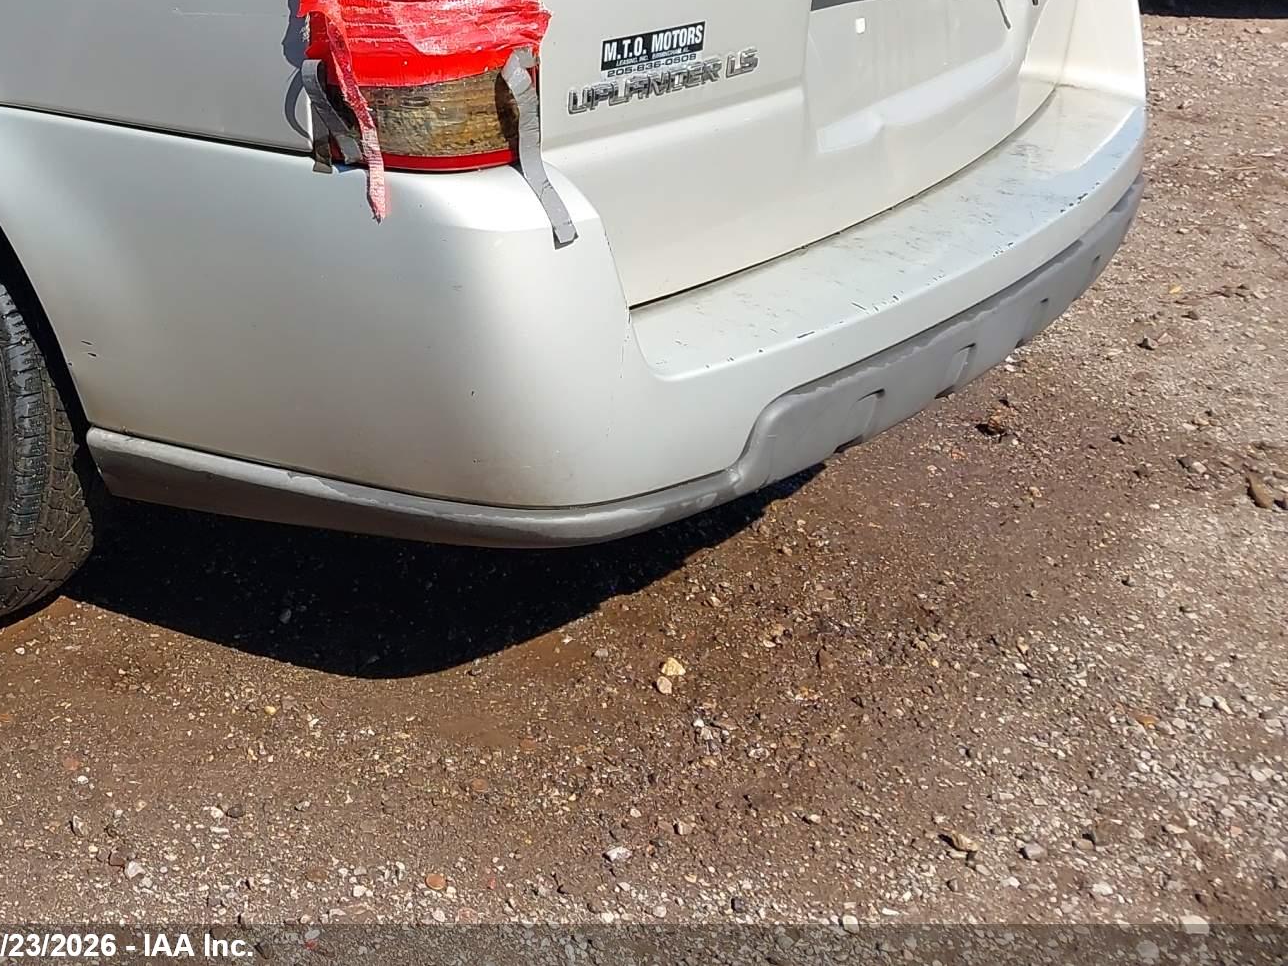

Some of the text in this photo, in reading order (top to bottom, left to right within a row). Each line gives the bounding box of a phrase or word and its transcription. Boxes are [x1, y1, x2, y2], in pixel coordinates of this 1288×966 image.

[603, 24, 704, 63] M.T.O. MOTORS
[567, 47, 759, 115] UPLANDER LS
